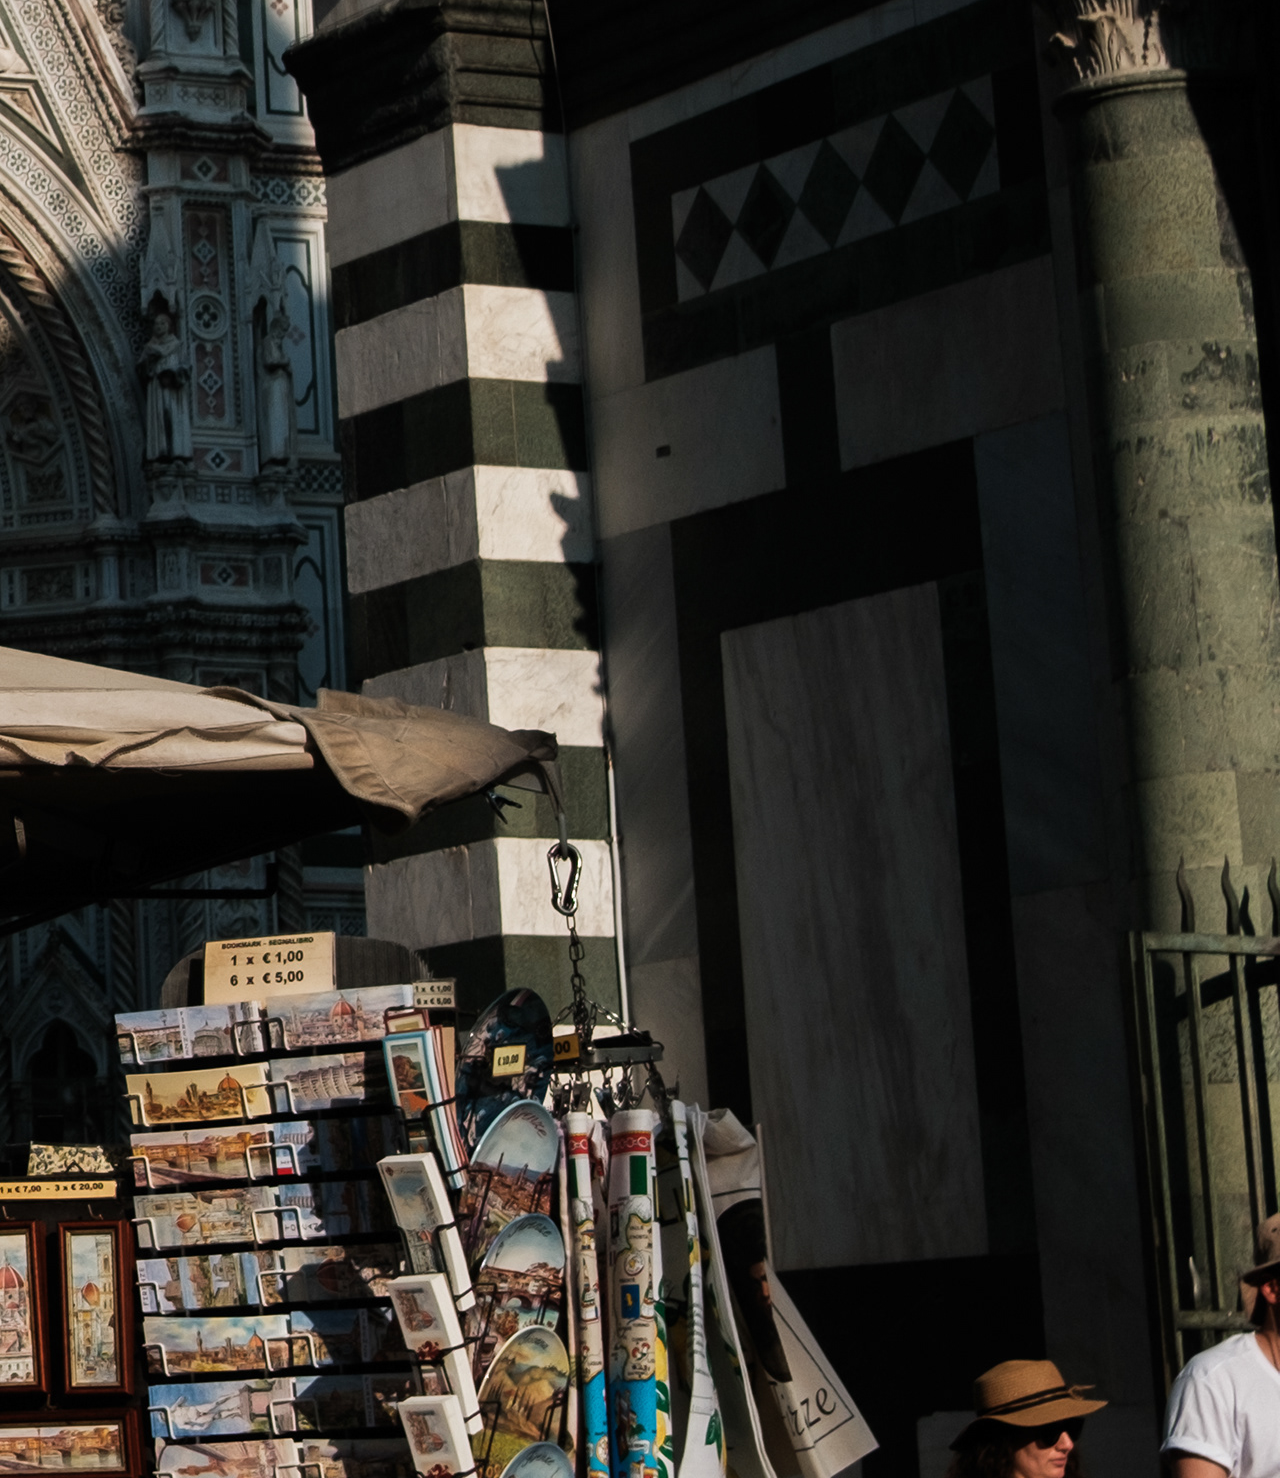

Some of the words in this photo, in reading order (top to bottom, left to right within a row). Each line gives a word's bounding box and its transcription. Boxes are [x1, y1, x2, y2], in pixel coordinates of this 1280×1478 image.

[221, 941, 262, 950] BOOKMARK
[231, 954, 237, 966] 1
[246, 957, 254, 965] x
[263, 953, 271, 963] €
[275, 950, 304, 964] 1,00
[230, 975, 238, 986] 6
[246, 977, 254, 985] x
[263, 973, 271, 983] €
[275, 970, 304, 984] 5,00
[23, 1185, 42, 1194] 7,00
[54, 1184, 60, 1192] 3
[78, 1182, 104, 1191] 20,00
